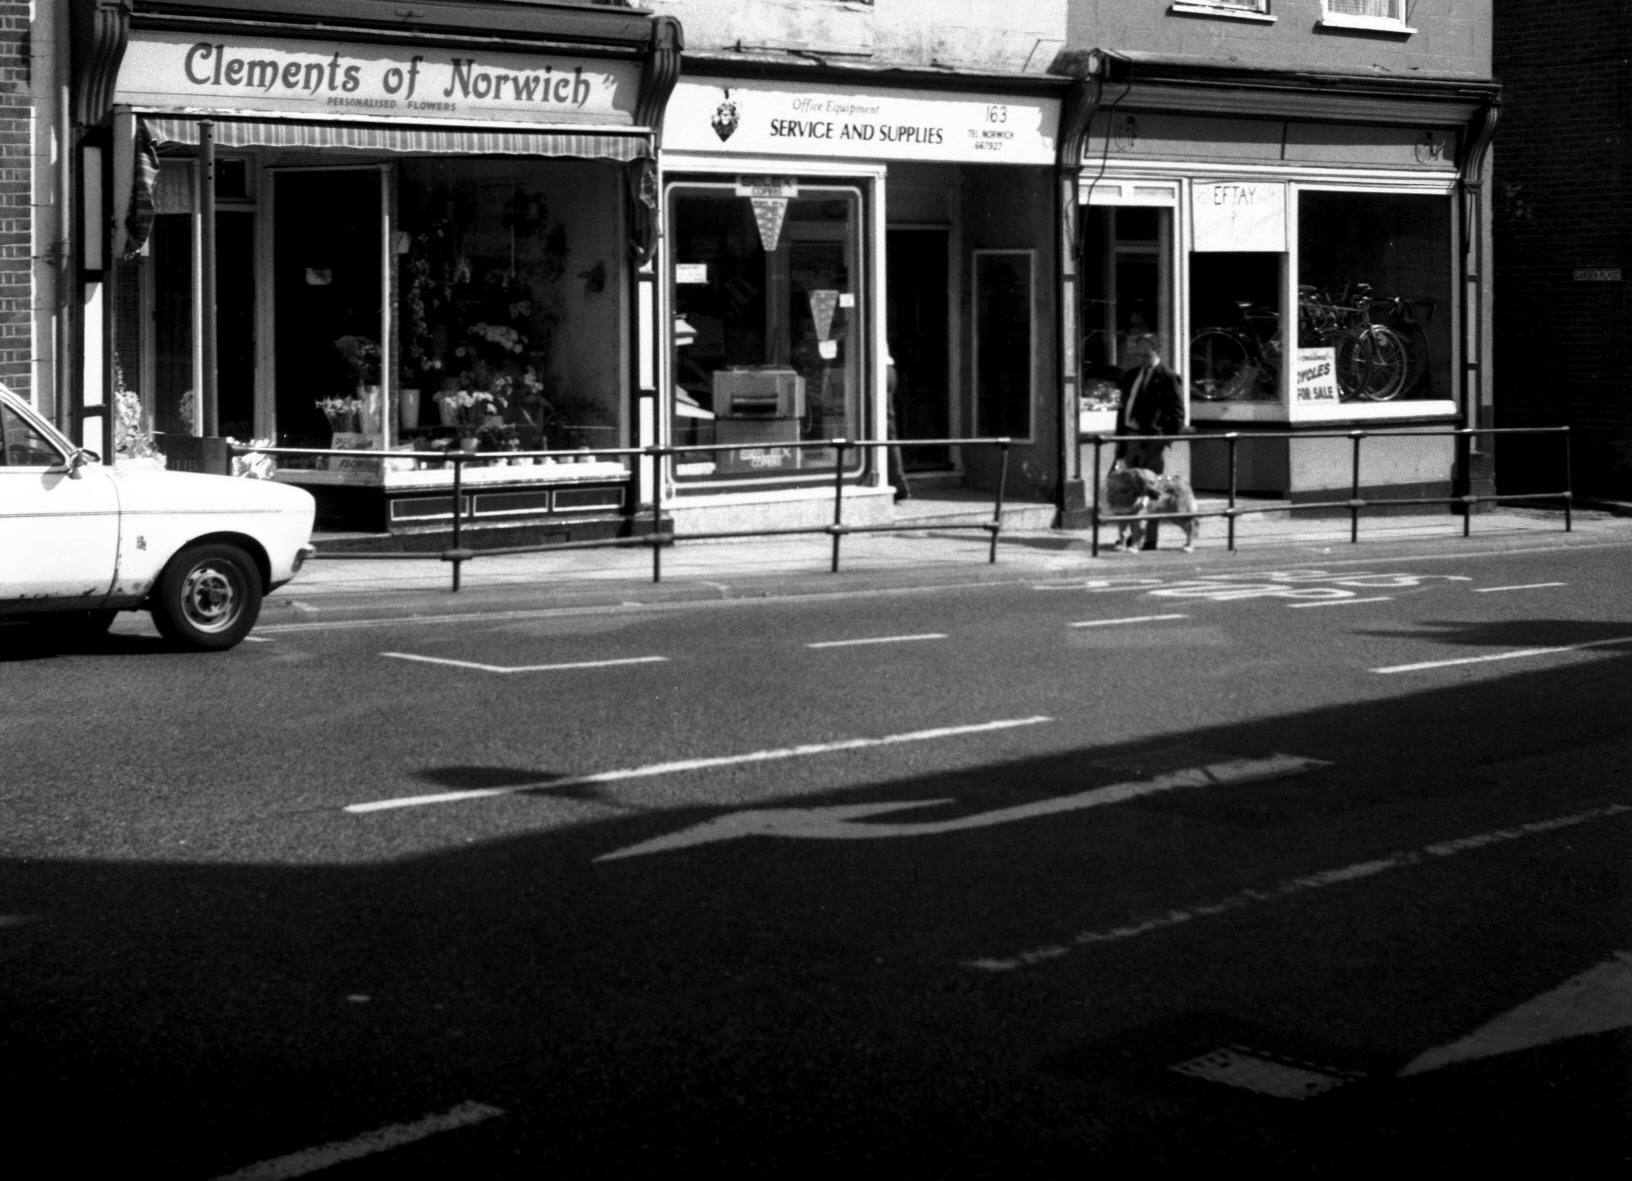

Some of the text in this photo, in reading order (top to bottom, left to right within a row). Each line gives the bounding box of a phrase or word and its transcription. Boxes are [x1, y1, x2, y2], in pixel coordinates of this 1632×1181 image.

[184, 42, 591, 108] Clements of Norwich
[327, 96, 457, 112] PERSONALISED FLOWERS
[792, 98, 880, 115] Office Equipment
[986, 105, 1007, 123] 163
[770, 118, 943, 145] SERVICE AND SUPPLIES
[1313, 386, 1334, 400] SALE
